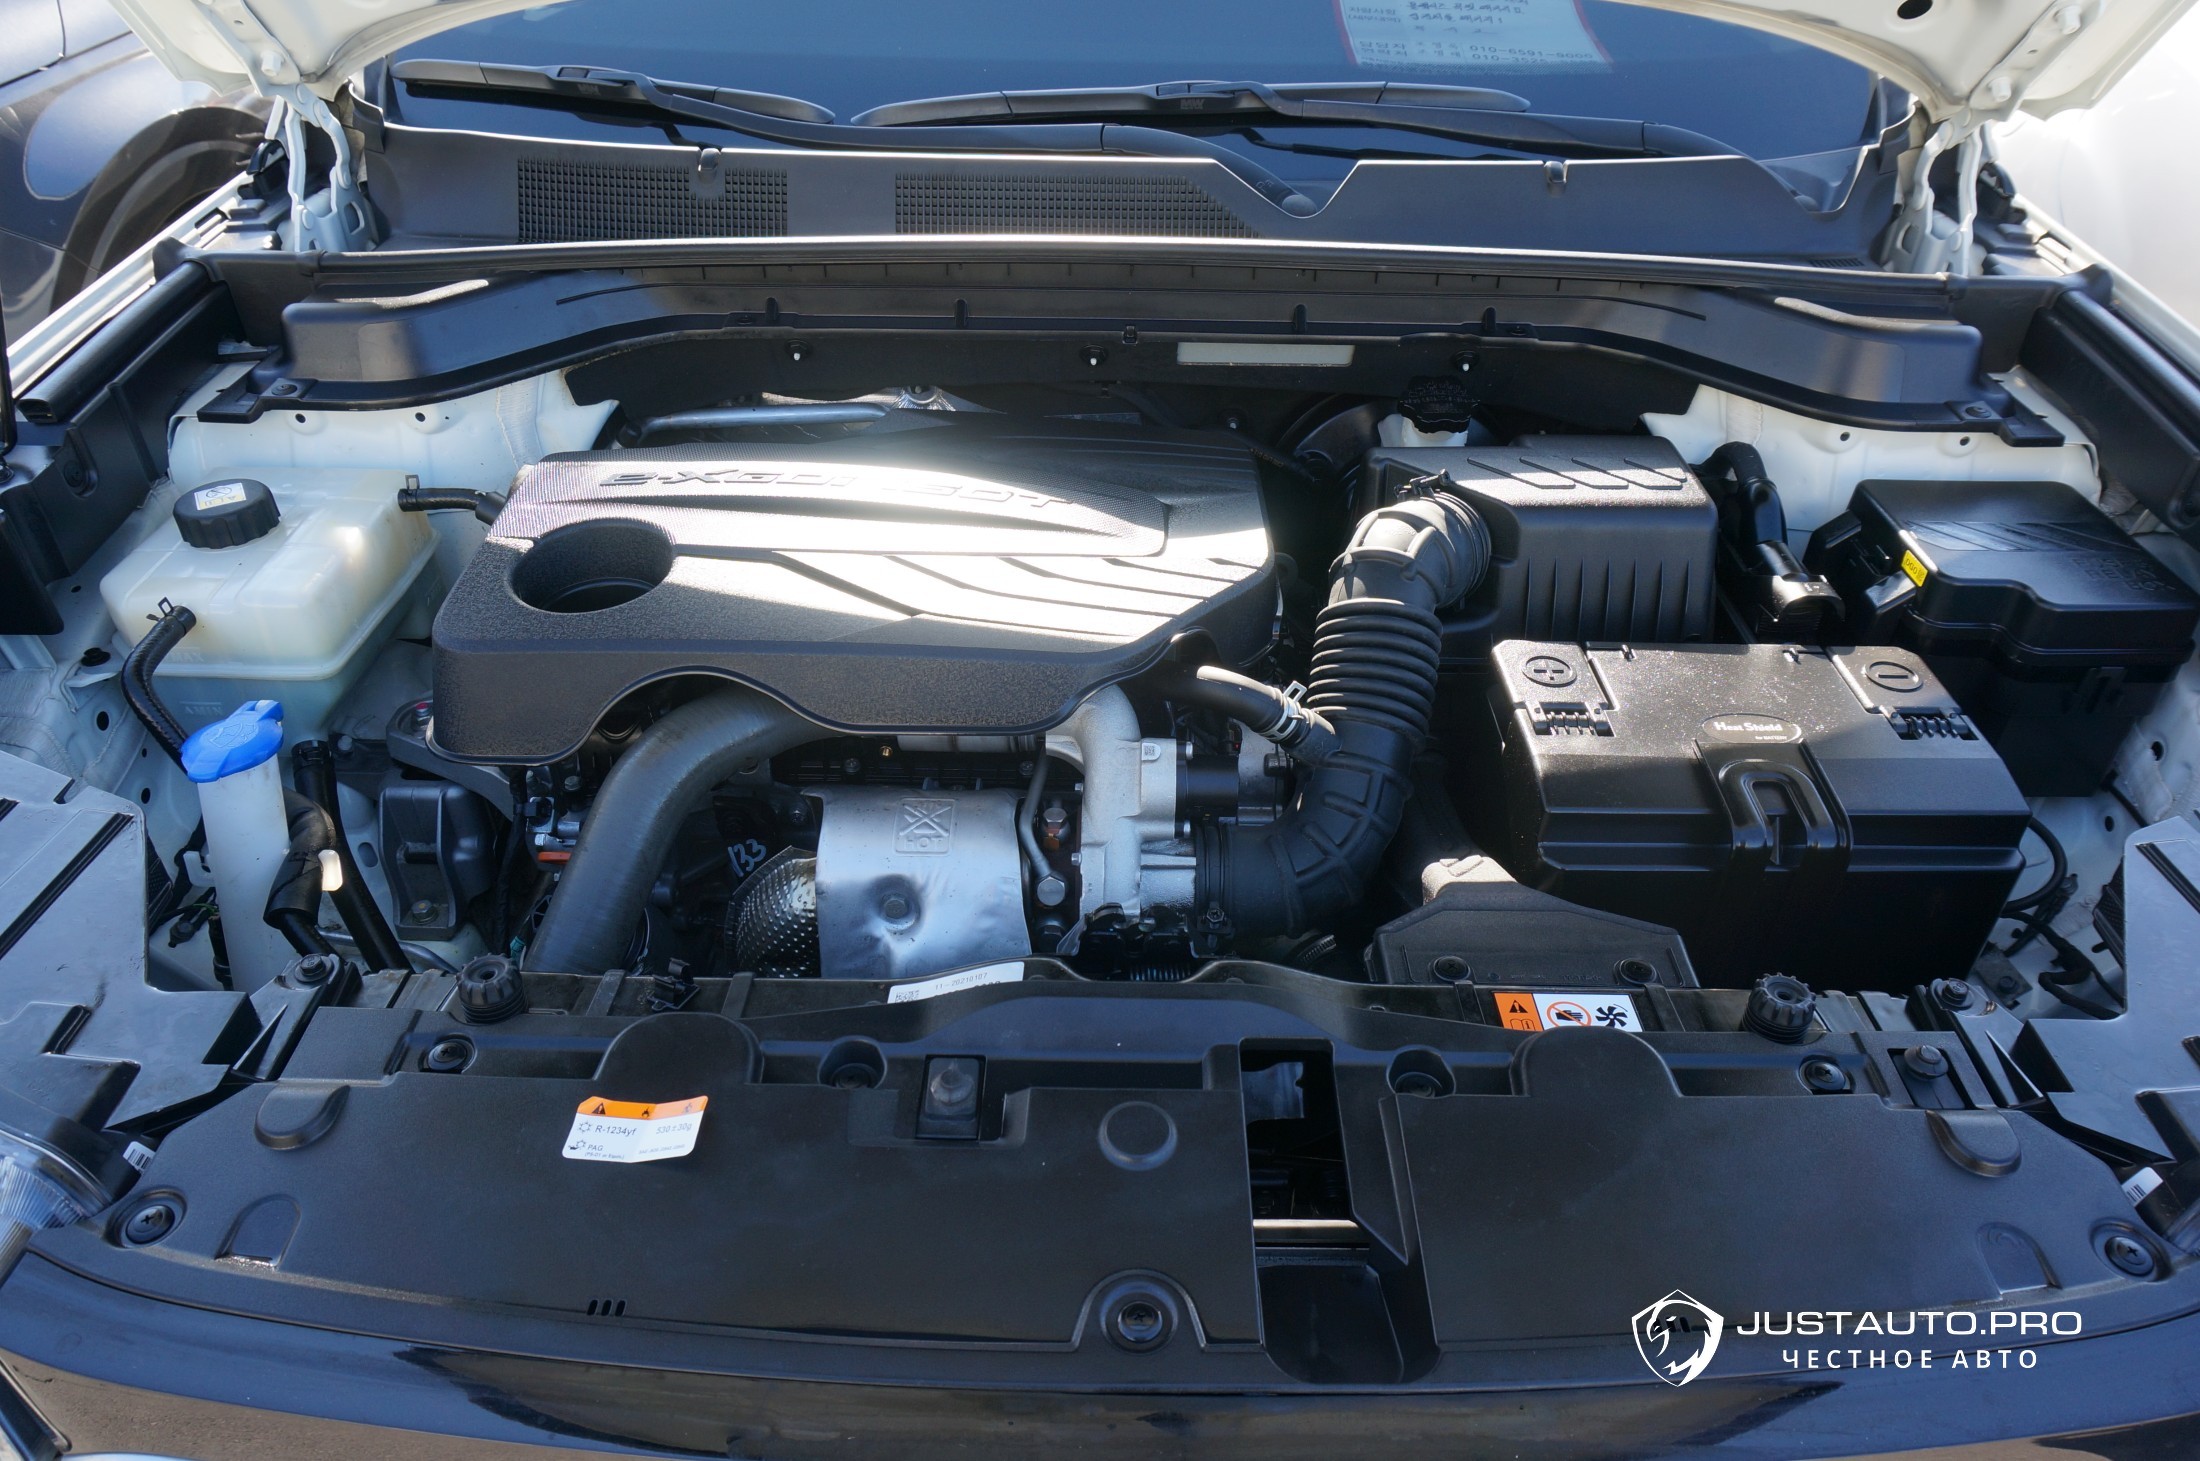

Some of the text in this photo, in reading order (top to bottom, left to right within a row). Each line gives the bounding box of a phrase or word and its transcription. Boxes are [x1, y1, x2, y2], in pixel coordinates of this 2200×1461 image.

[904, 837, 944, 850] HOT
[727, 838, 766, 877] 133
[595, 1124, 637, 1138] R-1234yf
[587, 1144, 604, 1152] PAG
